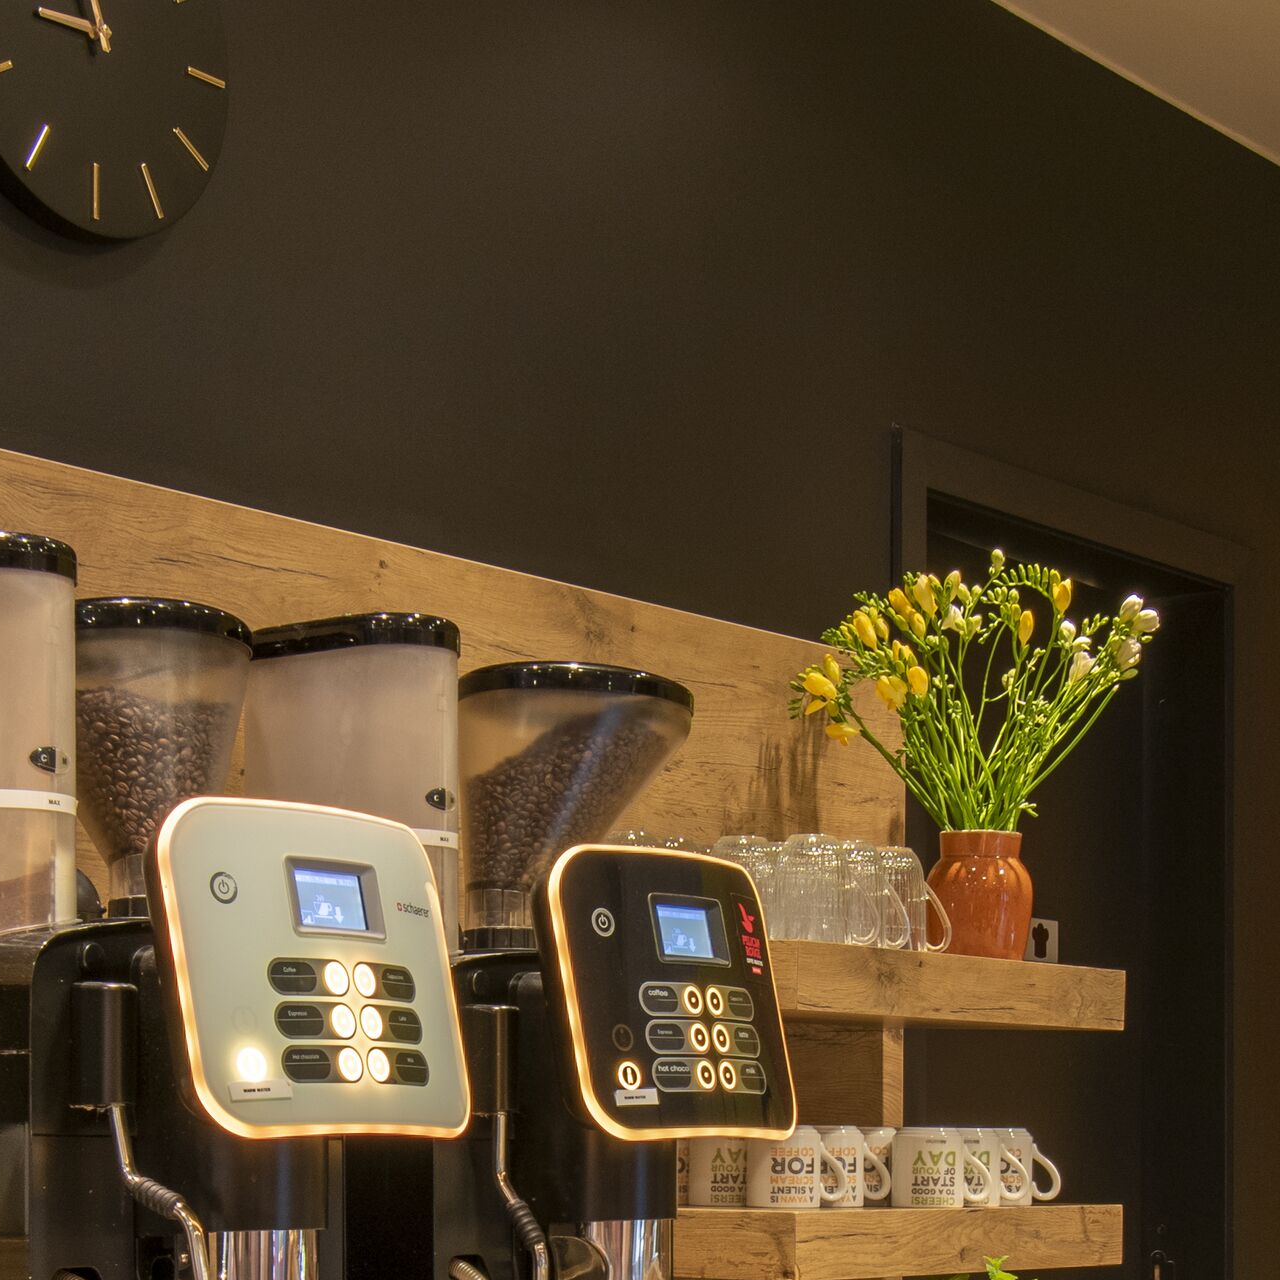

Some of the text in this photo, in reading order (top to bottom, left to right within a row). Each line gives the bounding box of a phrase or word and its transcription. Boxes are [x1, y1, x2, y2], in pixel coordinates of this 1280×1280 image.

[48, 798, 61, 806] MAX
[648, 989, 669, 997] coffee
[670, 1065, 690, 1073] choco
[770, 1147, 815, 1157] COFFEE
[912, 1150, 956, 1167] DAY
[711, 1164, 740, 1173] YOUR
[770, 1157, 815, 1175] FOR
[912, 1167, 956, 1176] OF YOUR
[710, 1173, 747, 1185] TART
[769, 1175, 814, 1185] SCREAM
[911, 1176, 955, 1187] START
[710, 1185, 736, 1193] GOOD
[770, 1185, 806, 1195] SILENT
[808, 1185, 814, 1194] A
[851, 1185, 857, 1194] A
[770, 1195, 814, 1204] A YAWN IS
[851, 1195, 857, 1203] A
[911, 1197, 956, 1206] CHEERS!
